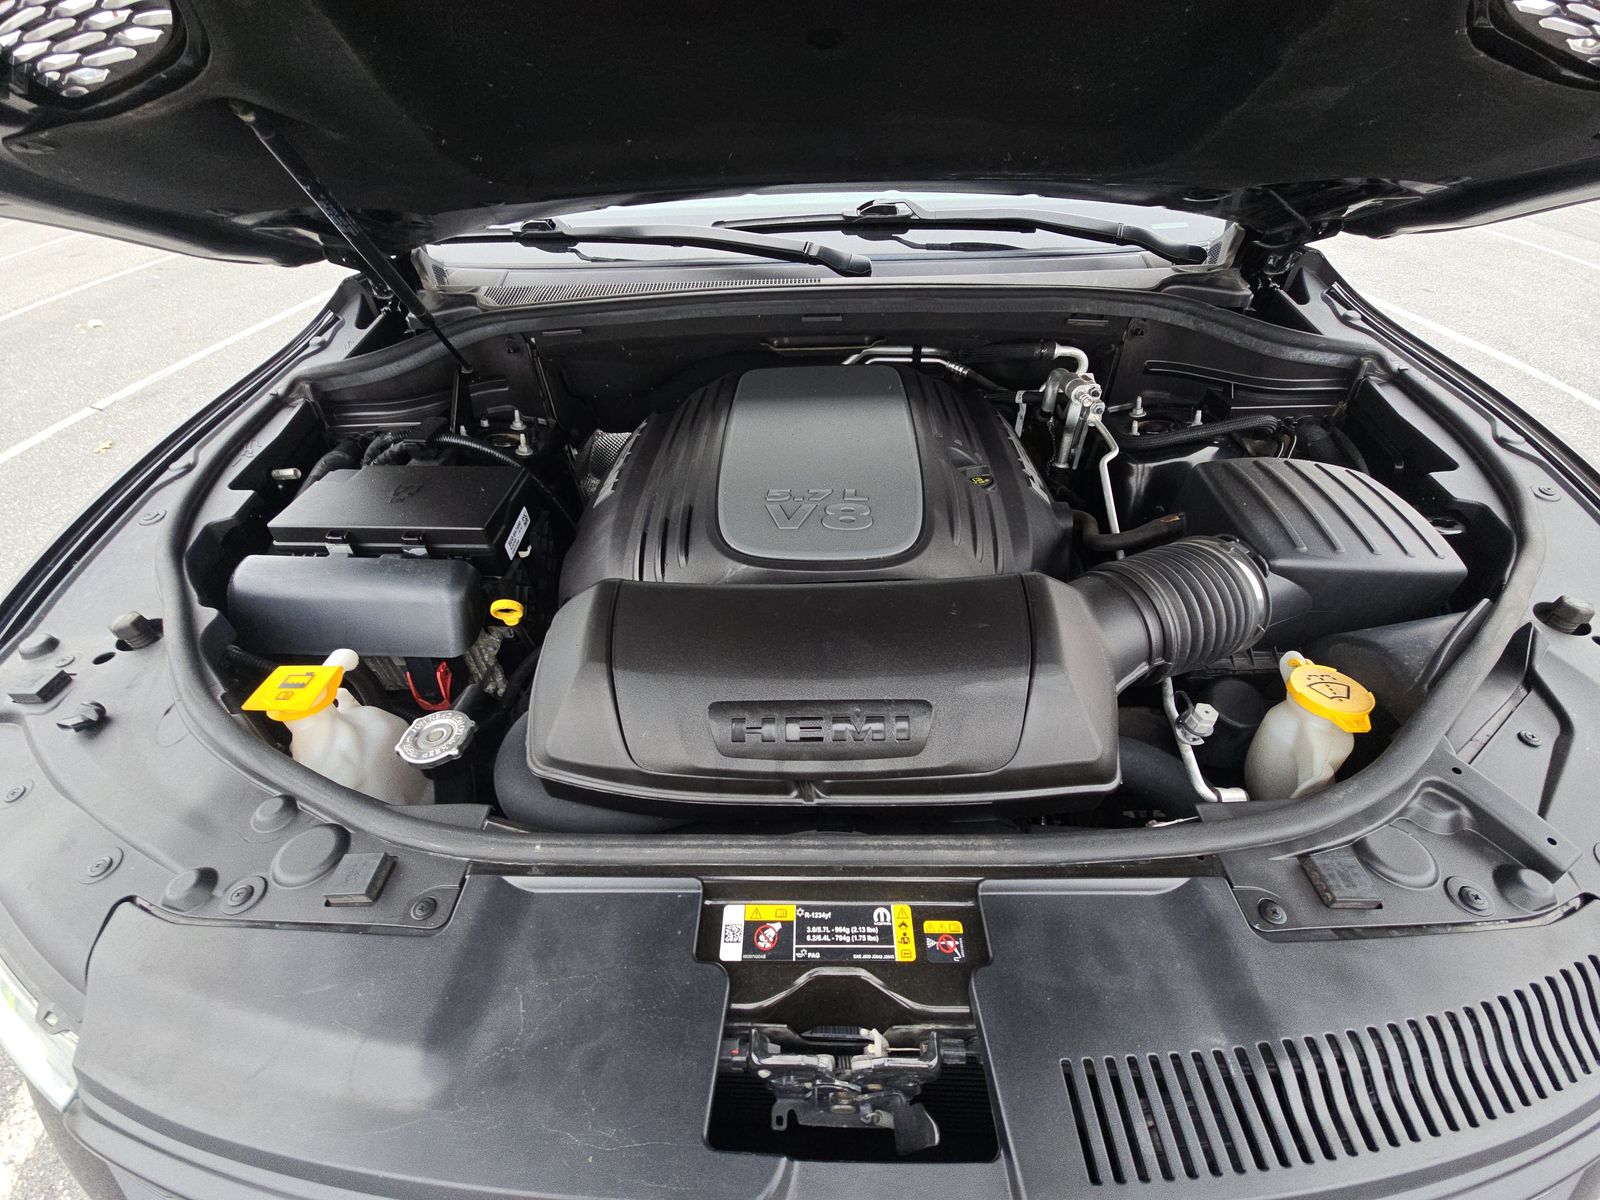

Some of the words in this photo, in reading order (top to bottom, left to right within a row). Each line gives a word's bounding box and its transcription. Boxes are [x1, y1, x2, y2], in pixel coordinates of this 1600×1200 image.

[765, 503, 874, 531] V8
[730, 715, 911, 743] HEMI
[804, 911, 832, 920] R-1234yf
[850, 926, 866, 934] (2.13
[866, 926, 879, 934] lbs)
[851, 934, 867, 943] (1.75
[866, 934, 879, 943] lbs)
